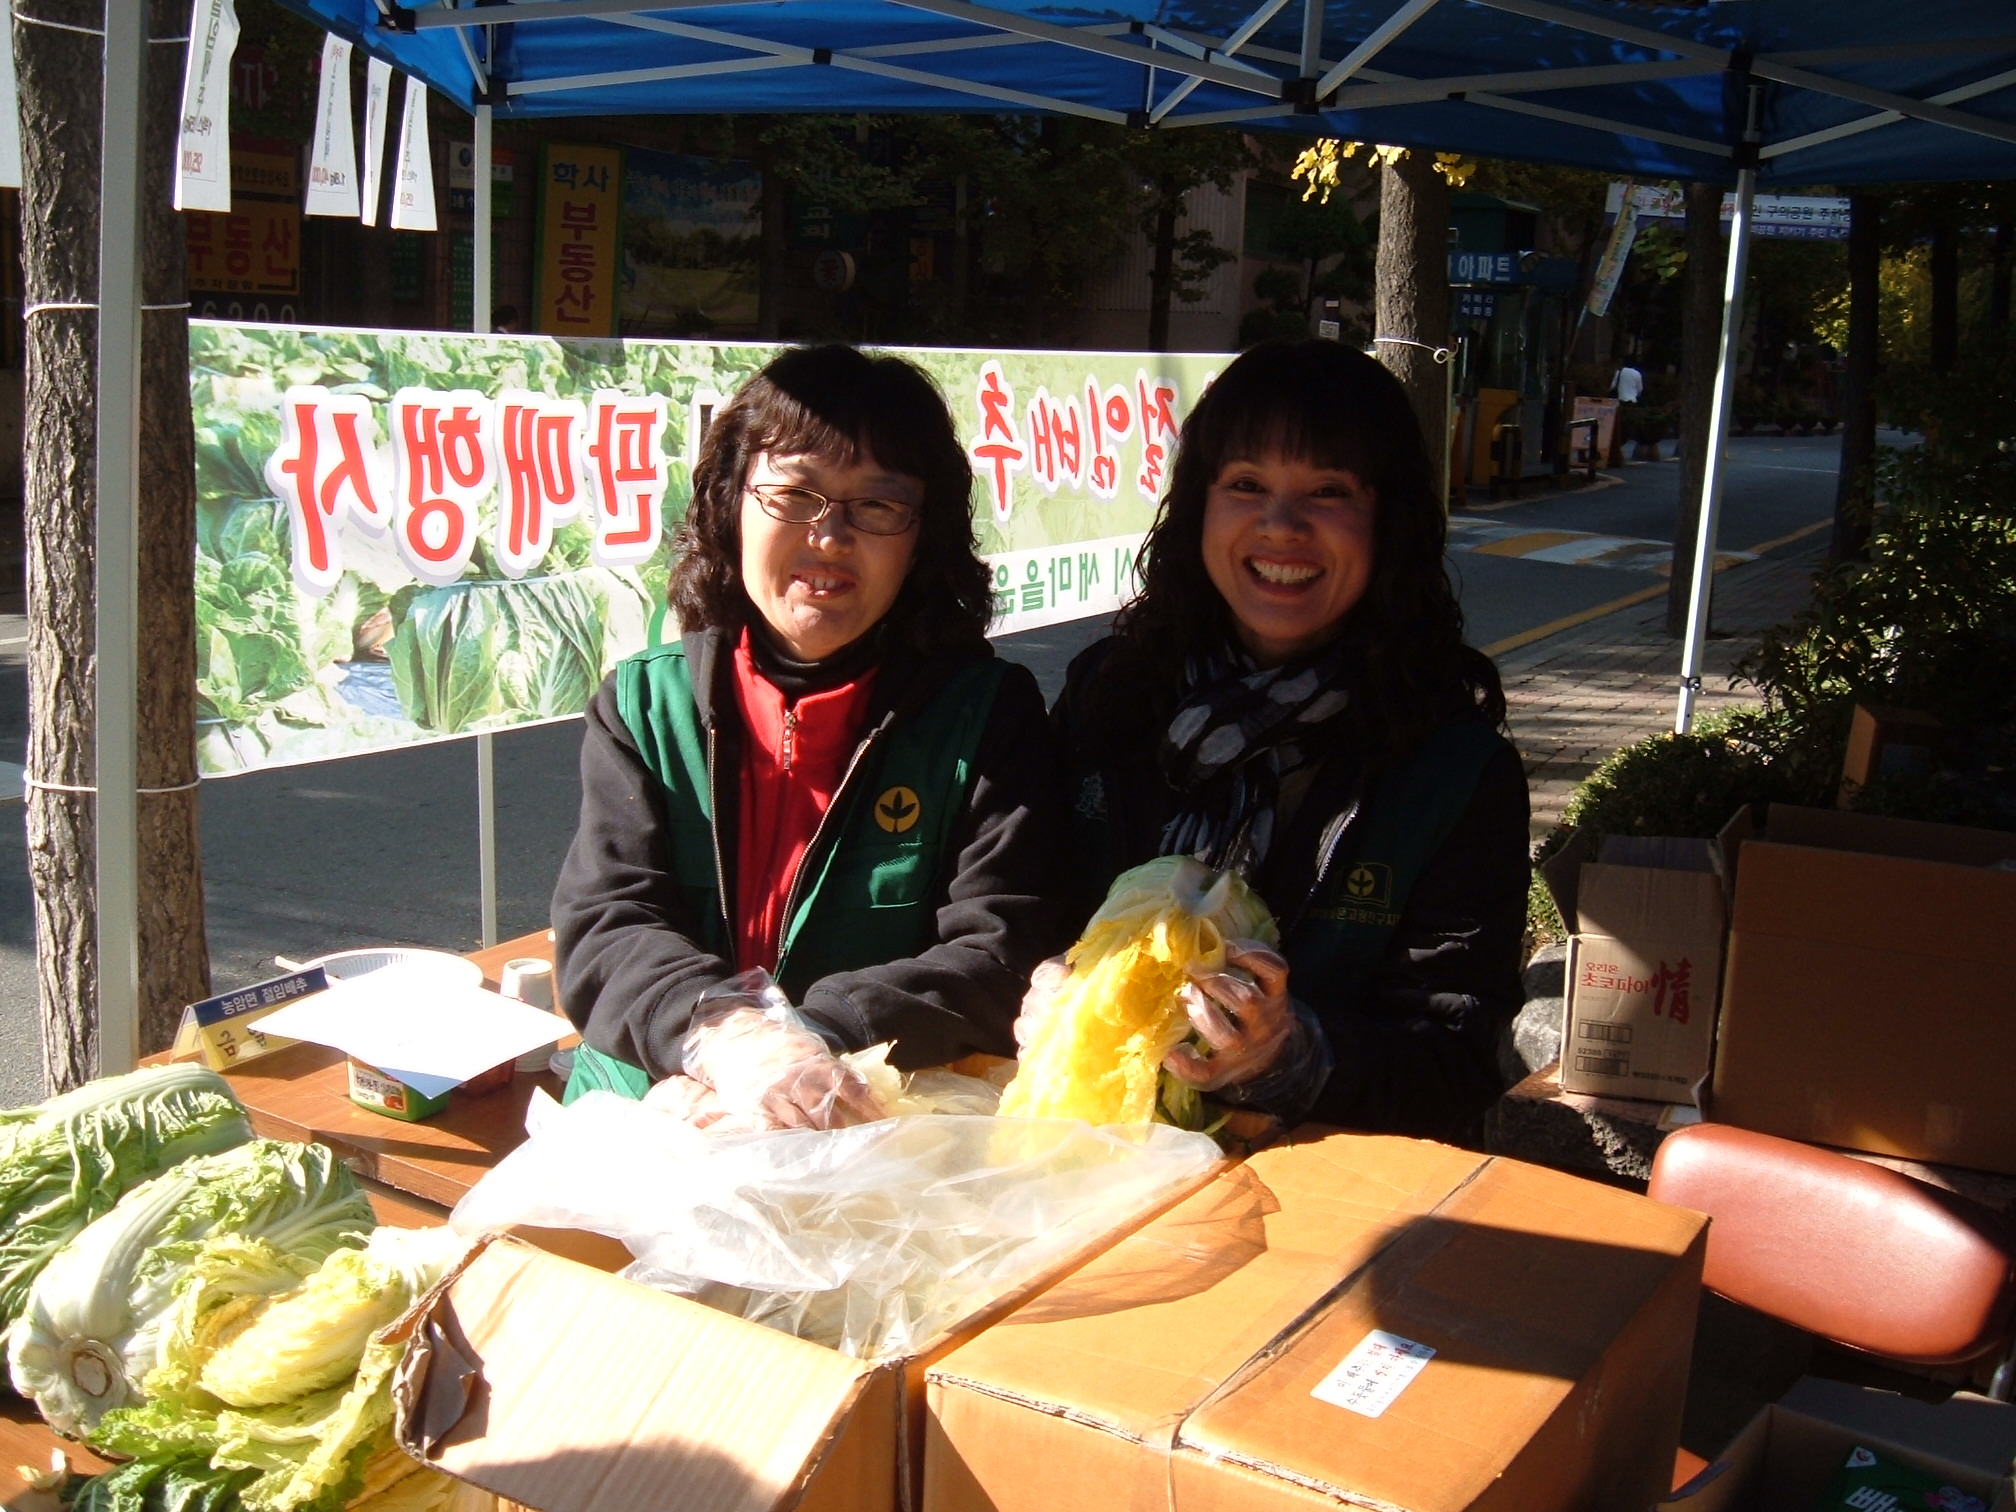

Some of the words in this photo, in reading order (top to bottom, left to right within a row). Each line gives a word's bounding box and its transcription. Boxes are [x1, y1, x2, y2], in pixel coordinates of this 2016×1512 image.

[553, 162, 609, 192] 학사
[1767, 204, 1814, 221] 구의공원
[187, 213, 292, 276] 부동산
[555, 202, 598, 324] 부동산
[1458, 254, 1511, 282] 아파트
[1585, 961, 1620, 975] 오리온
[221, 993, 259, 1016] 농암면
[261, 977, 308, 1002] 절임배추
[1581, 972, 1649, 995] 초코파이
[1650, 957, 1693, 1025] 情
